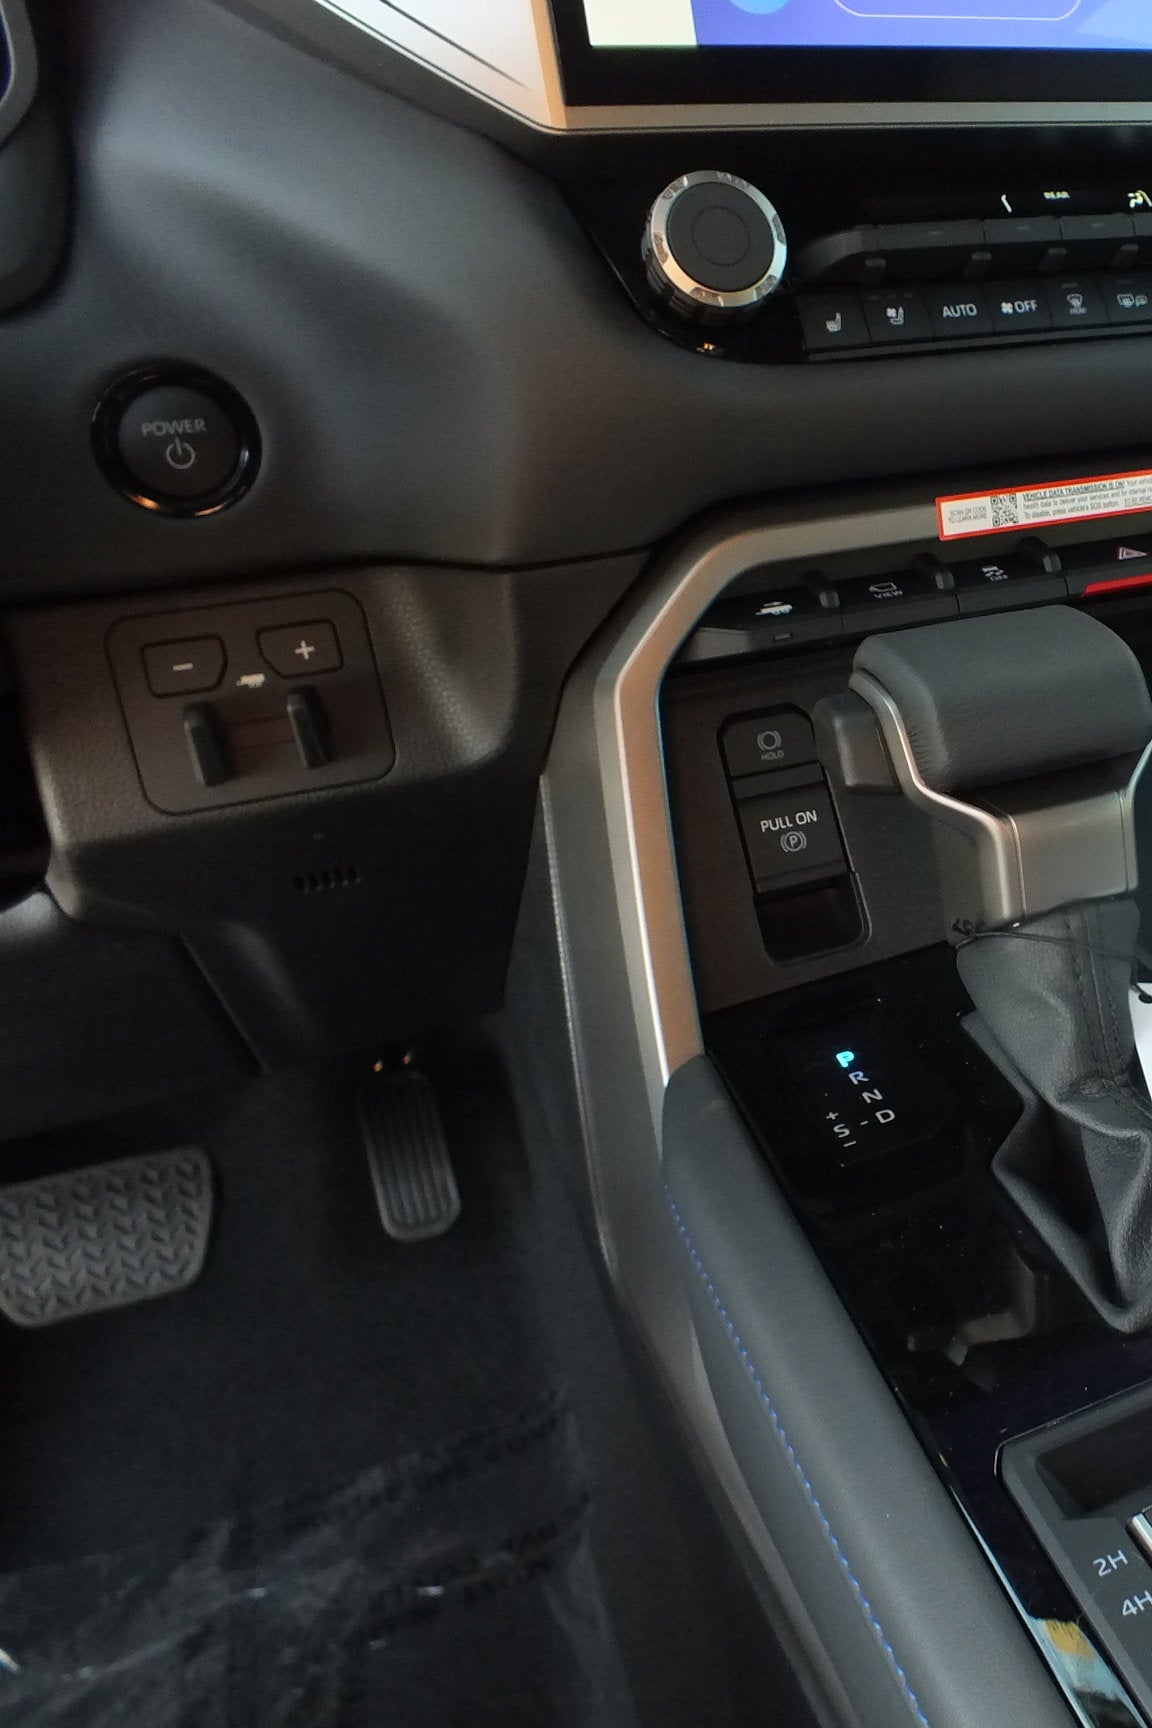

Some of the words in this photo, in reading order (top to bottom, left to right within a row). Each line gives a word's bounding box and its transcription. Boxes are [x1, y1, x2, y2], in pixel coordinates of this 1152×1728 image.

[941, 303, 978, 318] AUTO
[1014, 300, 1038, 313] OFF
[140, 417, 208, 437] POWER
[1023, 490, 1048, 500] VEHICLE
[1049, 488, 1064, 498] DATA
[1065, 483, 1108, 495] TRANSMISSION
[873, 590, 903, 599] VIEW
[760, 814, 793, 833] PULL
[795, 809, 818, 825] ON
[835, 1051, 855, 1068] P
[848, 1071, 870, 1085] R
[861, 1089, 884, 1104] N
[875, 1109, 895, 1124] D
[833, 1124, 850, 1138] S
[1092, 1550, 1129, 1577] 2H
